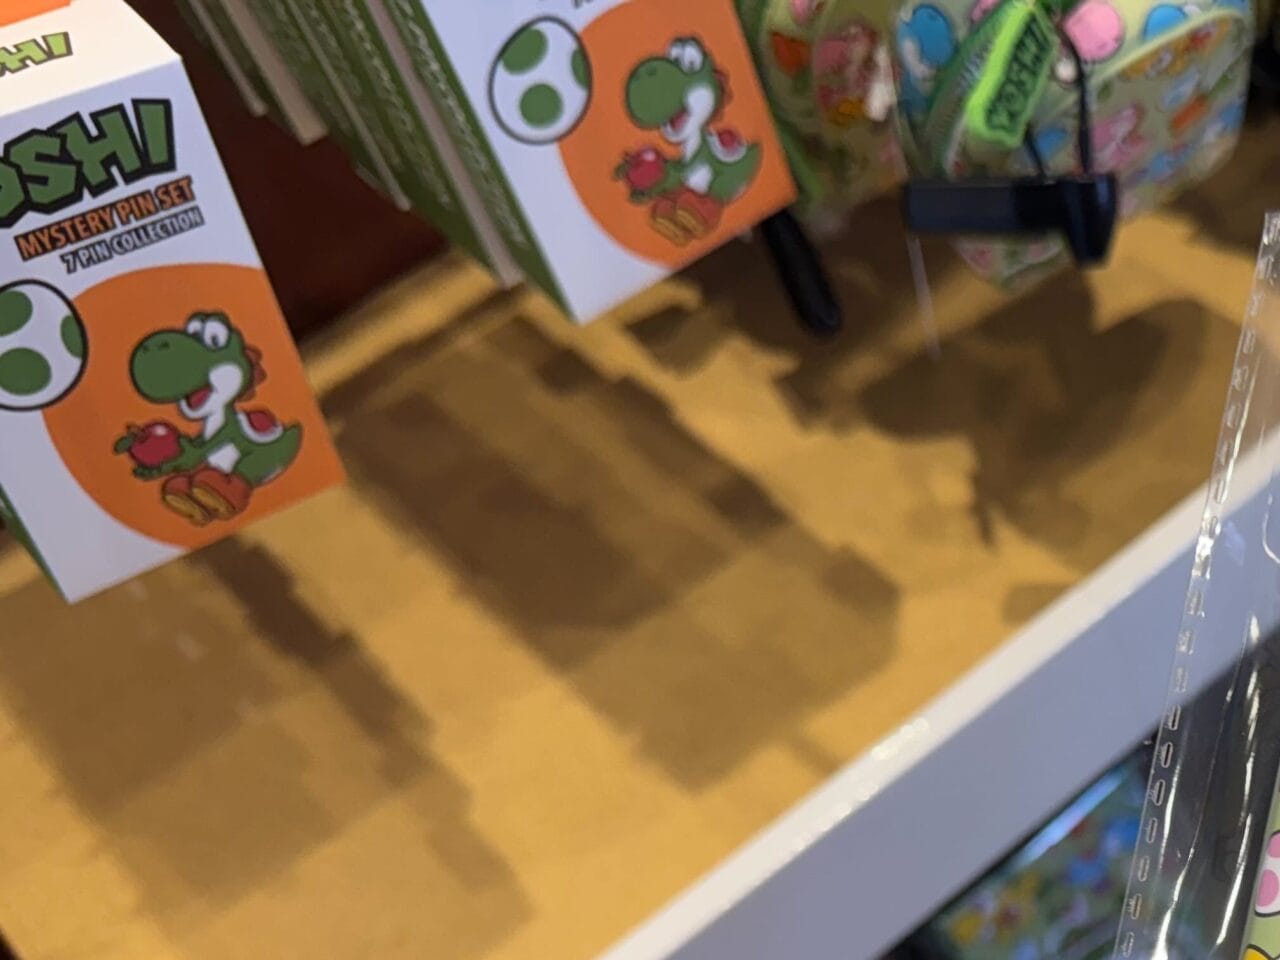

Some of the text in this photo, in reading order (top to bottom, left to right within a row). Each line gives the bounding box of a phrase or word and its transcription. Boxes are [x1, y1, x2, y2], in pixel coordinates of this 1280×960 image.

[0, 31, 73, 78] HI
[13, 175, 197, 262] MYSTERY PIN SET
[59, 205, 205, 274] 7 PIN COLLECTION
